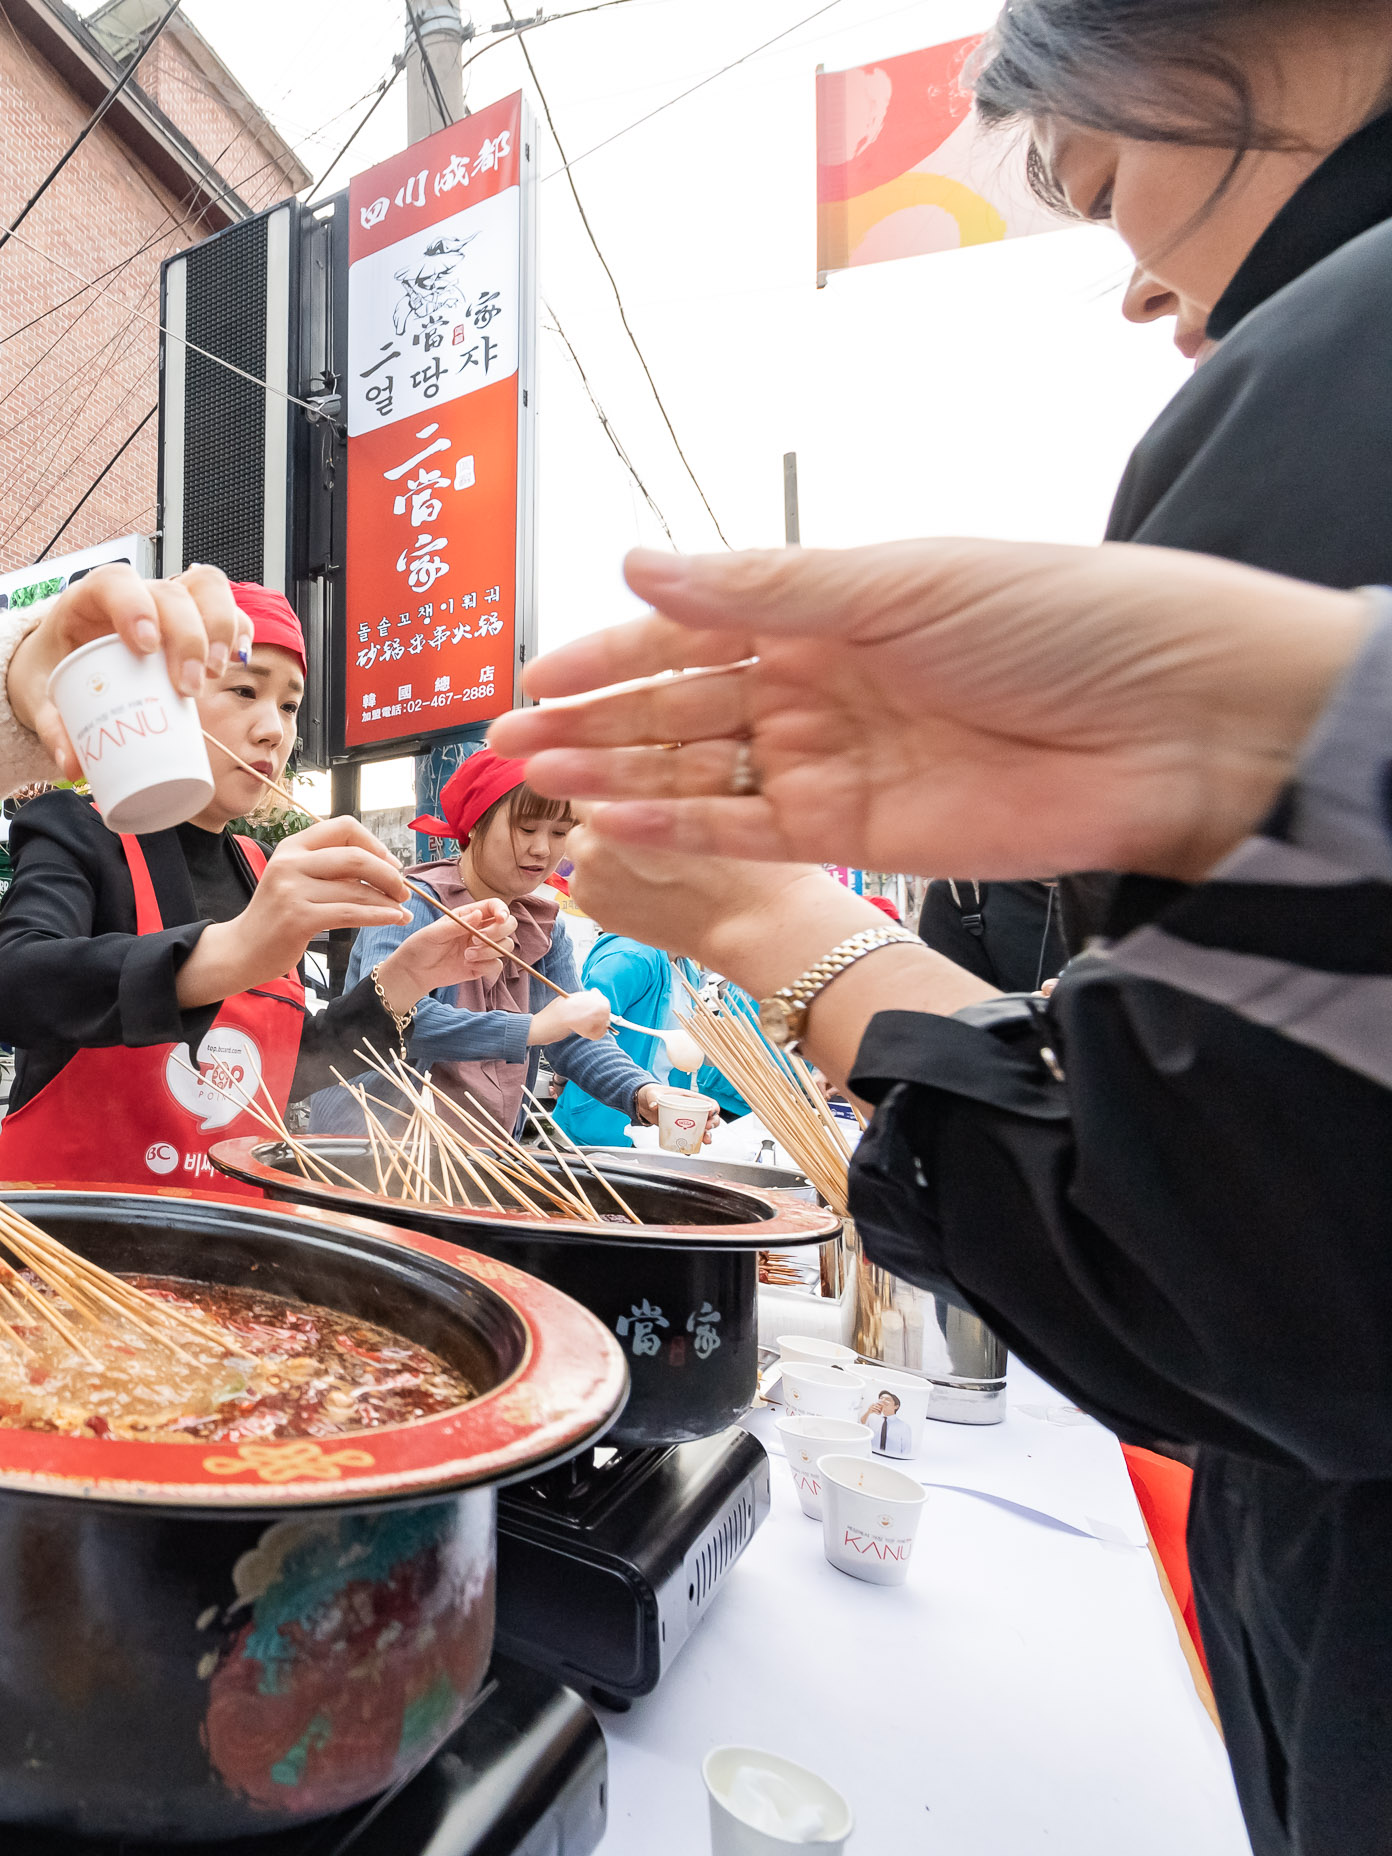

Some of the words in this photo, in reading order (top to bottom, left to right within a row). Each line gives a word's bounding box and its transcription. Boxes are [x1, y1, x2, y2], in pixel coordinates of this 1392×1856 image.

[79, 705, 169, 771] KANU
[147, 1145, 171, 1161] BC
[844, 1530, 912, 1561] KANU
